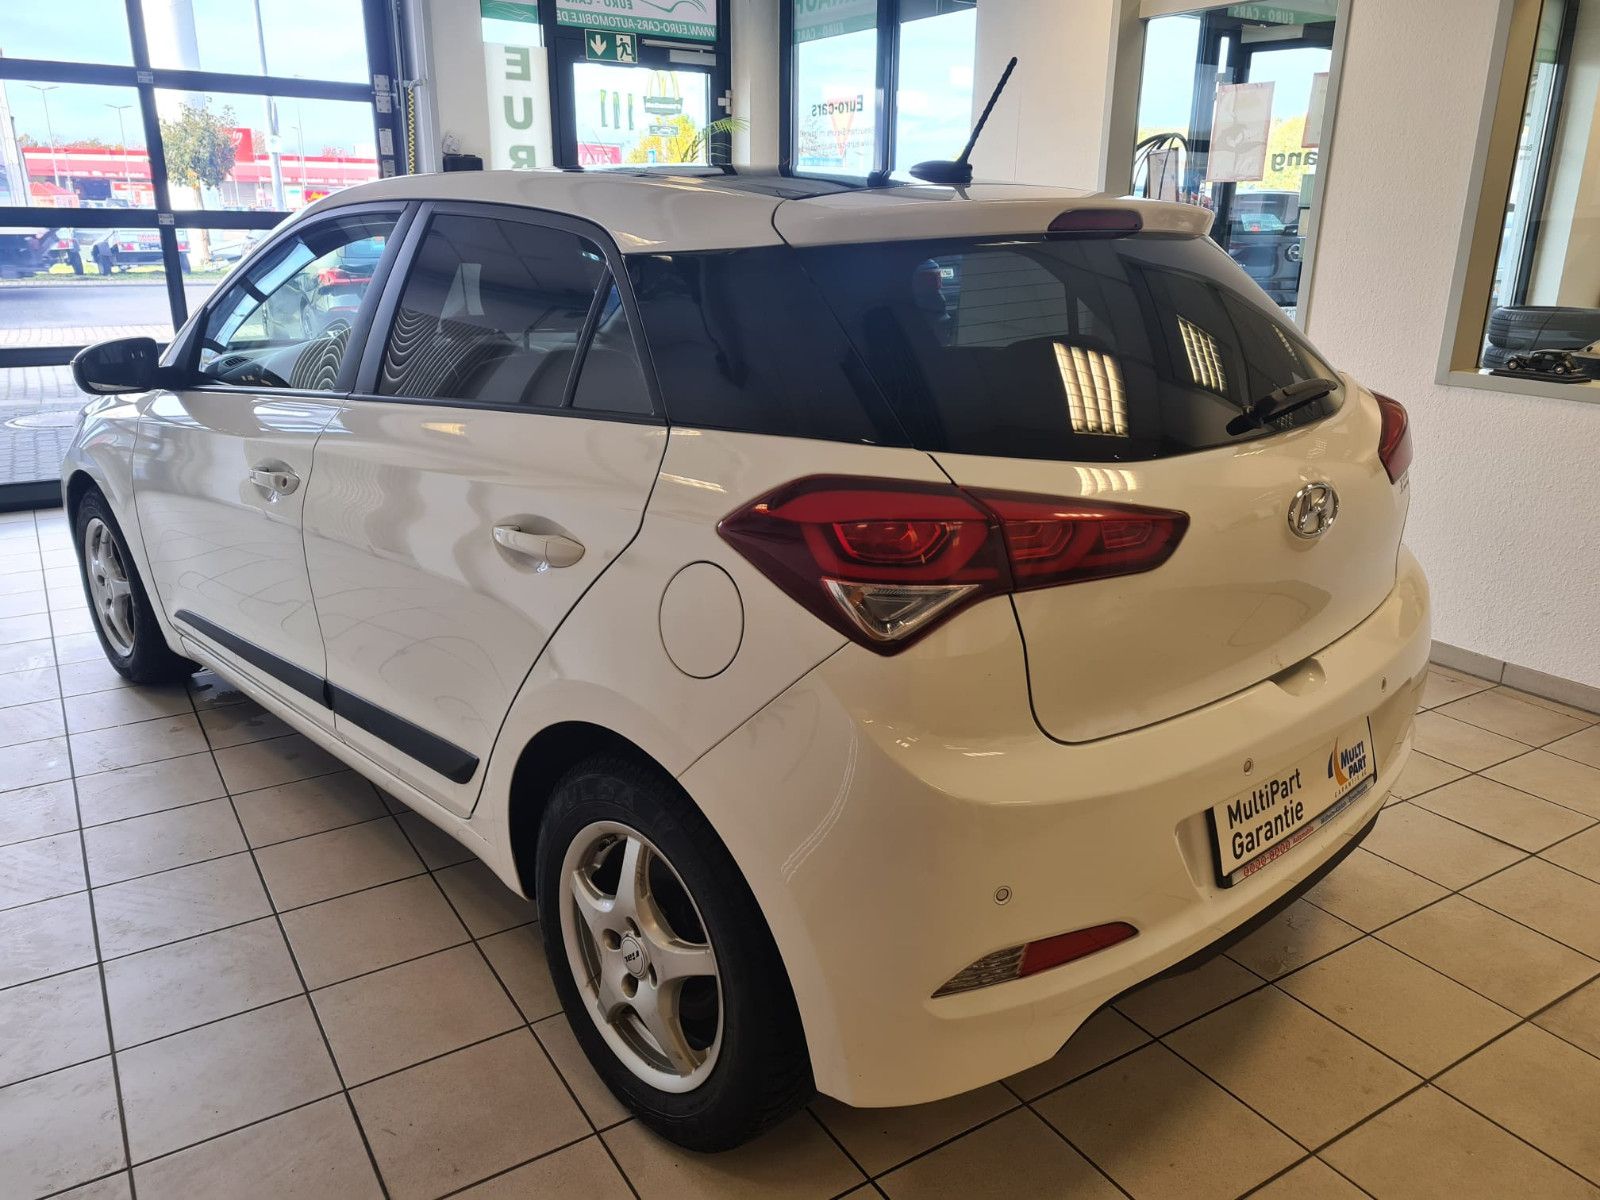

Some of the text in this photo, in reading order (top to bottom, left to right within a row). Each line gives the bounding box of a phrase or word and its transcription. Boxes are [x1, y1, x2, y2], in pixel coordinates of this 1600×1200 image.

[1348, 755, 1367, 779] PART
[1227, 768, 1302, 830] MultiPart
[1232, 801, 1304, 860] Garantie
